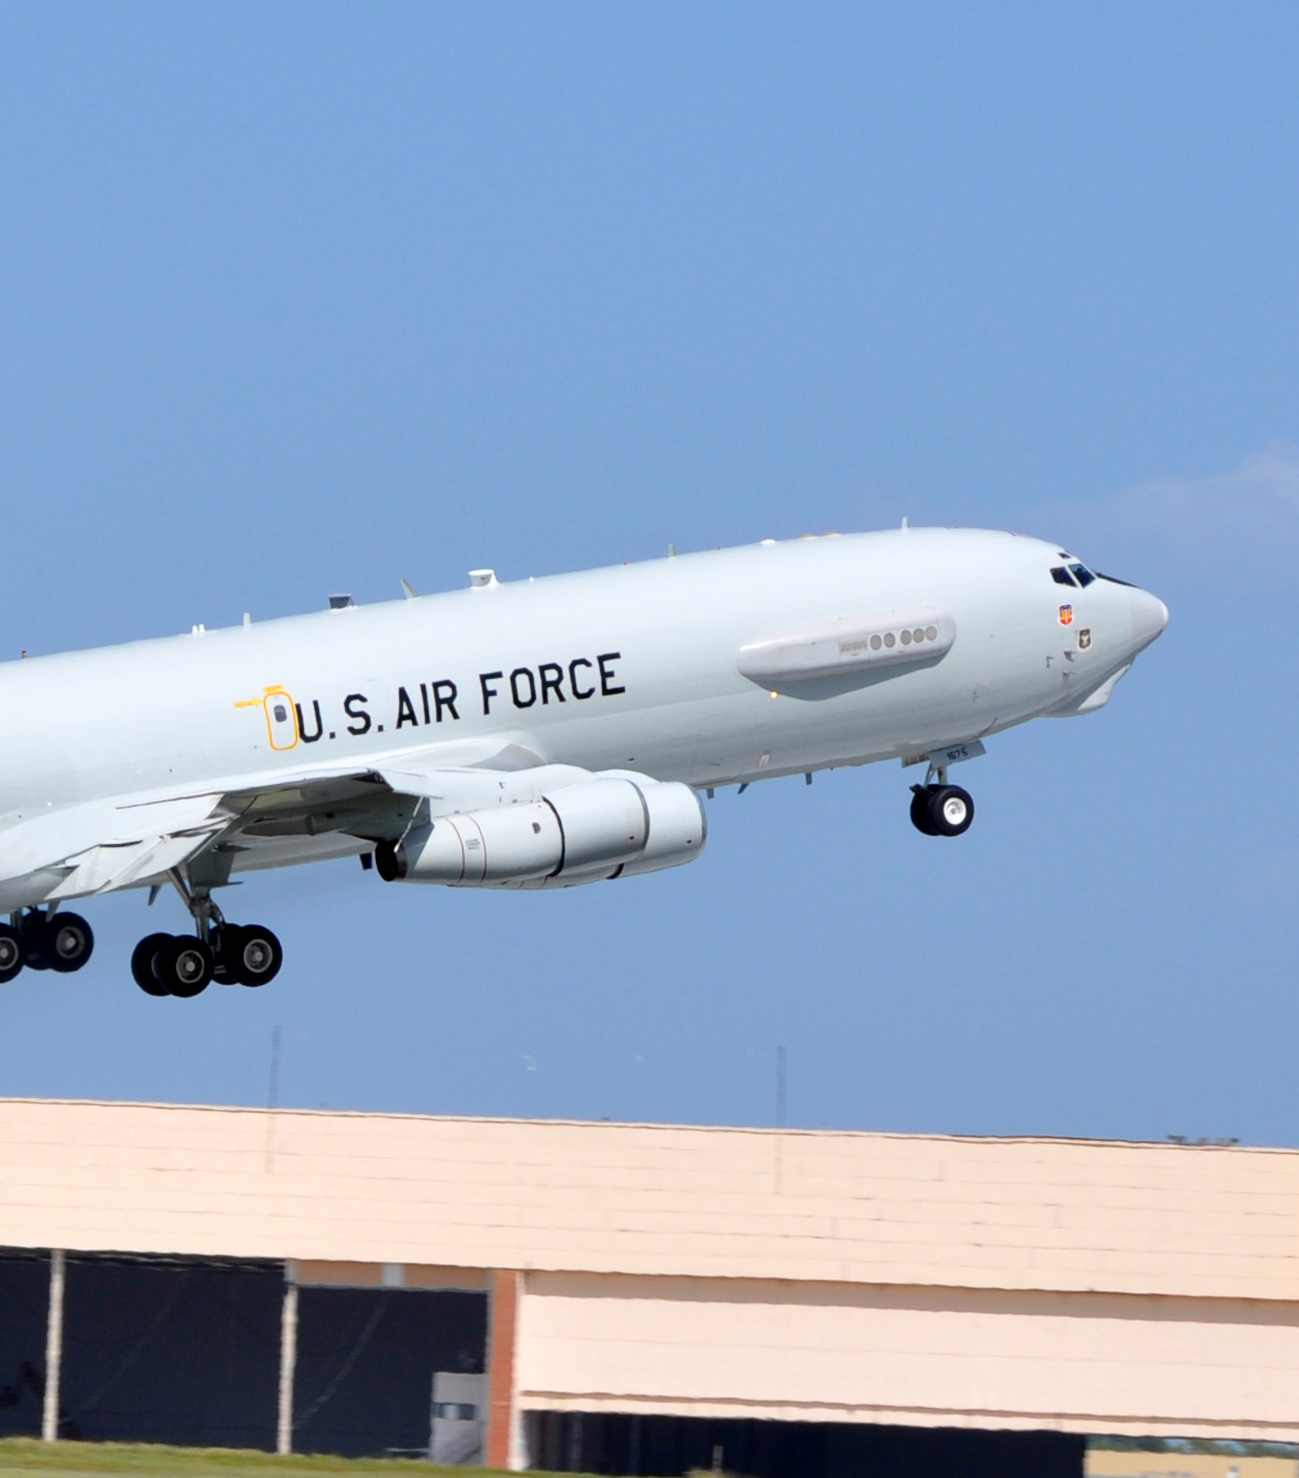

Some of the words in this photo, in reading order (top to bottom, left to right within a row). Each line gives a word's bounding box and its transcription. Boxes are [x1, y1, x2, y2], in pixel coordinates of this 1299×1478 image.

[295, 693, 385, 743] U.S.
[395, 678, 461, 729] AIR
[479, 652, 627, 716] FORCE
[946, 747, 968, 761] 1675
